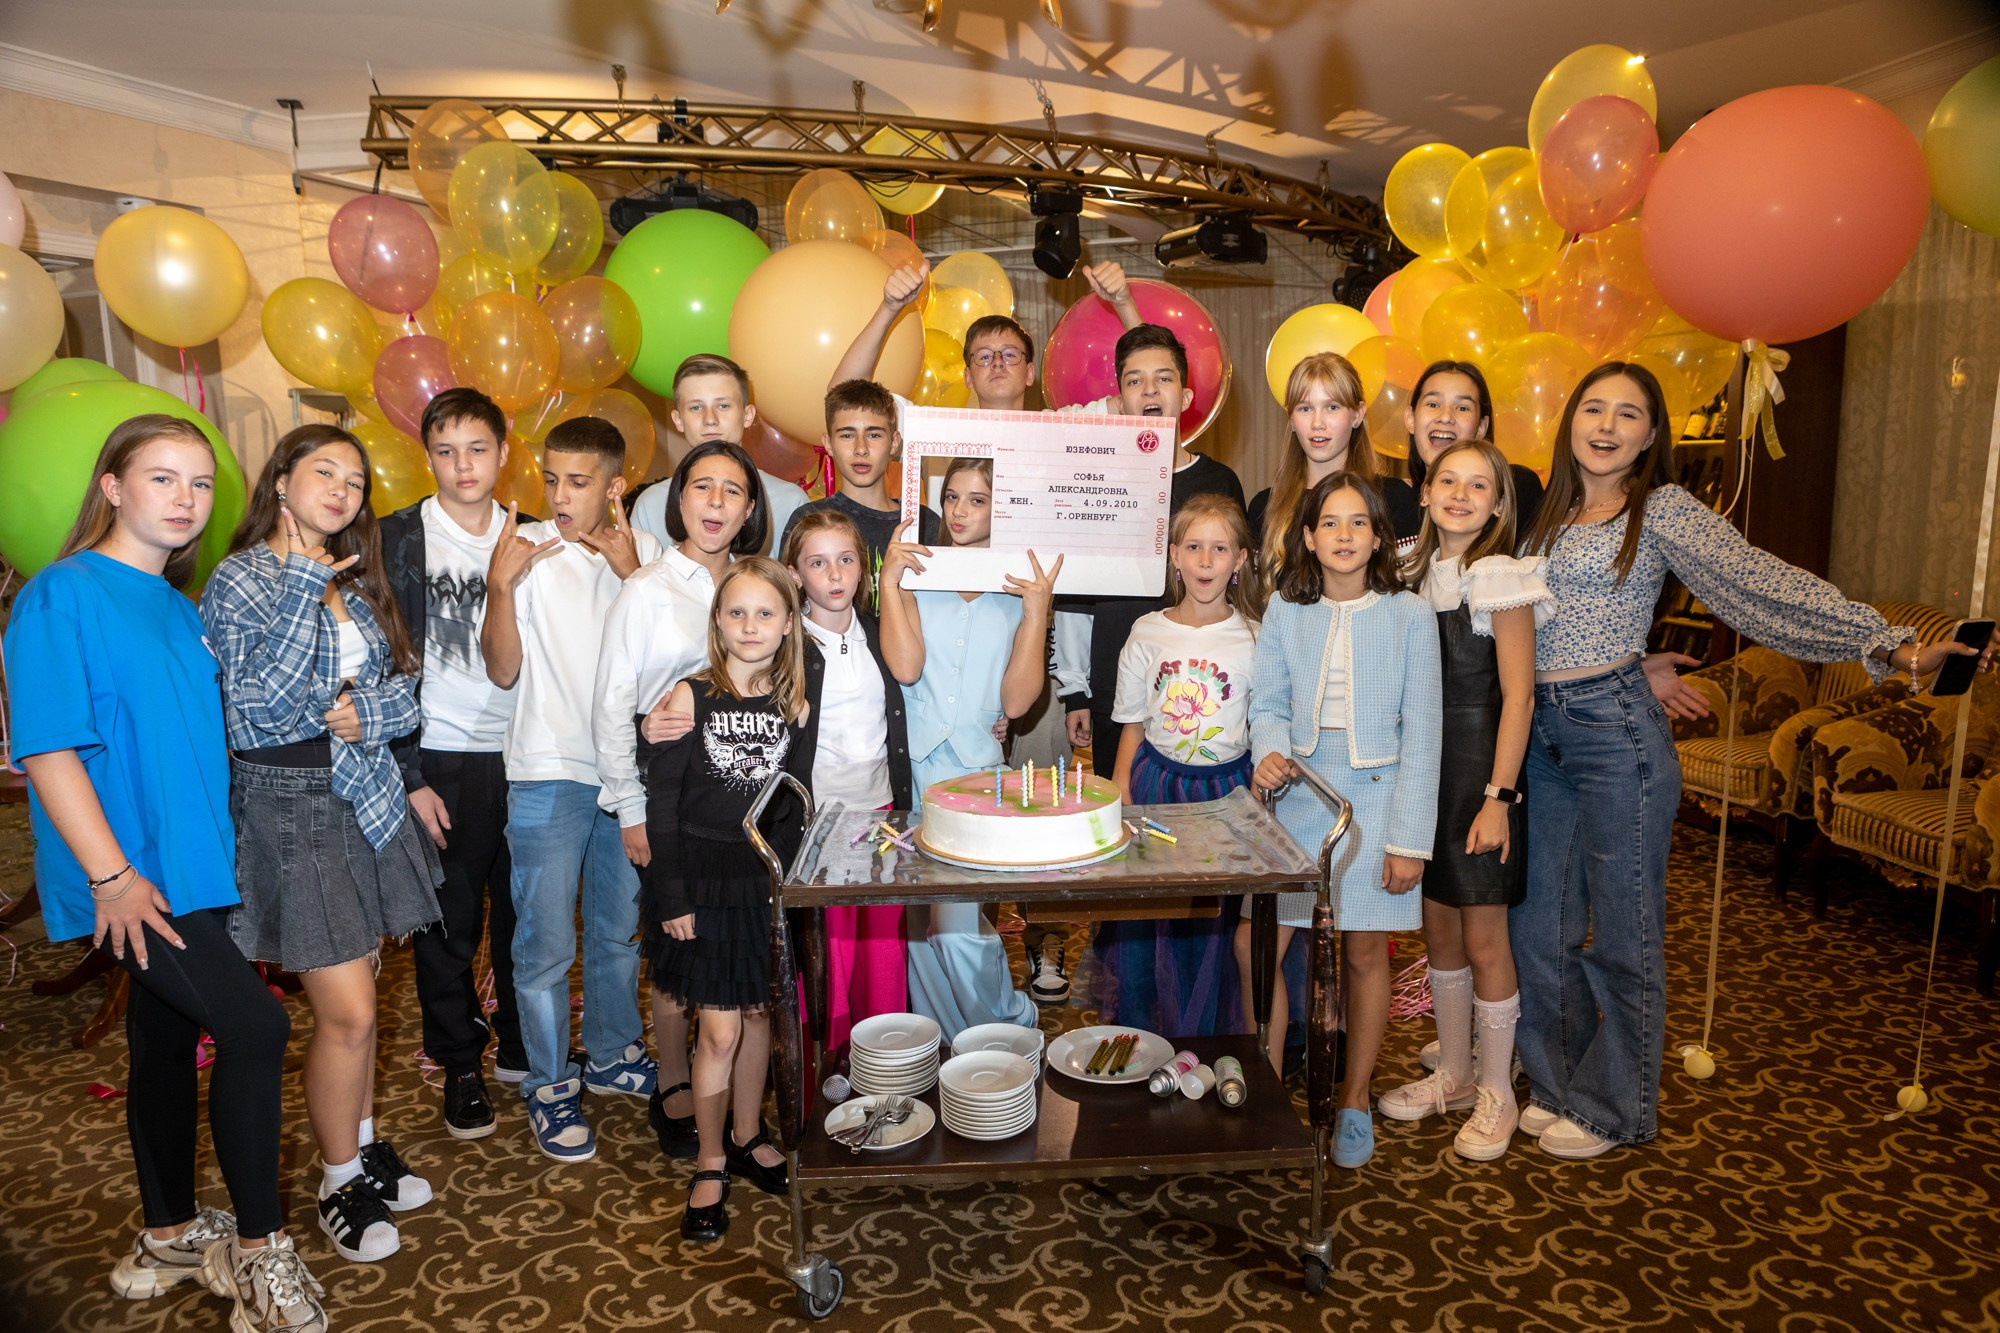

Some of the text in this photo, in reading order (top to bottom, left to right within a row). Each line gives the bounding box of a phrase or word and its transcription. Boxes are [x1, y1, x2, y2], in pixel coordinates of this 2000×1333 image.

[1065, 445, 1116, 455] ЮЗЕФОВИЧ
[1073, 472, 1105, 482] СОФЬЯ
[1048, 485, 1128, 496] АЛЕКСАНДРОВНА
[1009, 497, 1033, 505] ЖЕН.
[1083, 499, 1138, 509] 4.09.2010
[1056, 512, 1118, 521] Г.ОРЕНБУРГ
[709, 710, 784, 742] HEART
